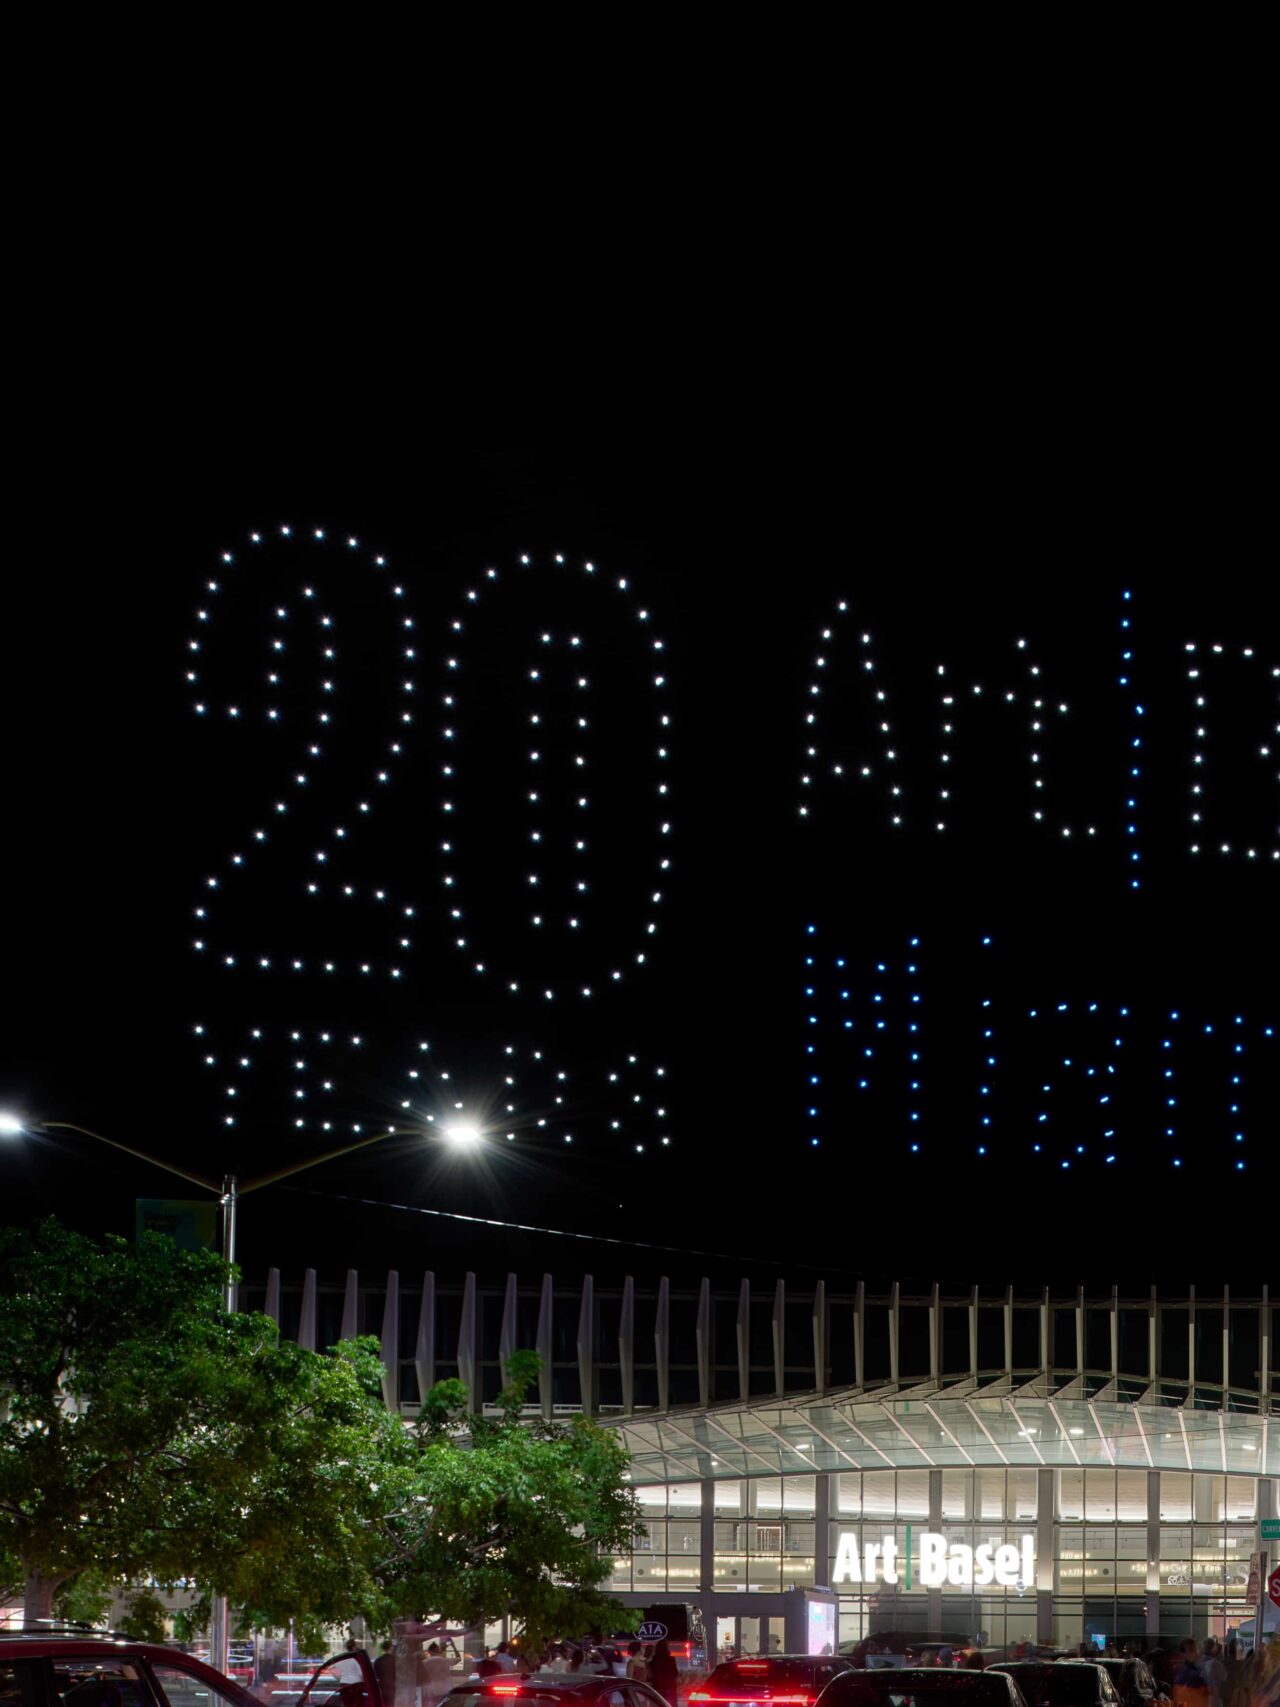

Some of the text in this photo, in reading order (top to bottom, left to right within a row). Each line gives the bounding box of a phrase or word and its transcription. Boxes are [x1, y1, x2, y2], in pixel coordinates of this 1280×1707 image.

[185, 524, 672, 1001] 20
[797, 600, 1098, 837] Art
[638, 1624, 663, 1635] A1A
[832, 1532, 1034, 1586] Art Basel
